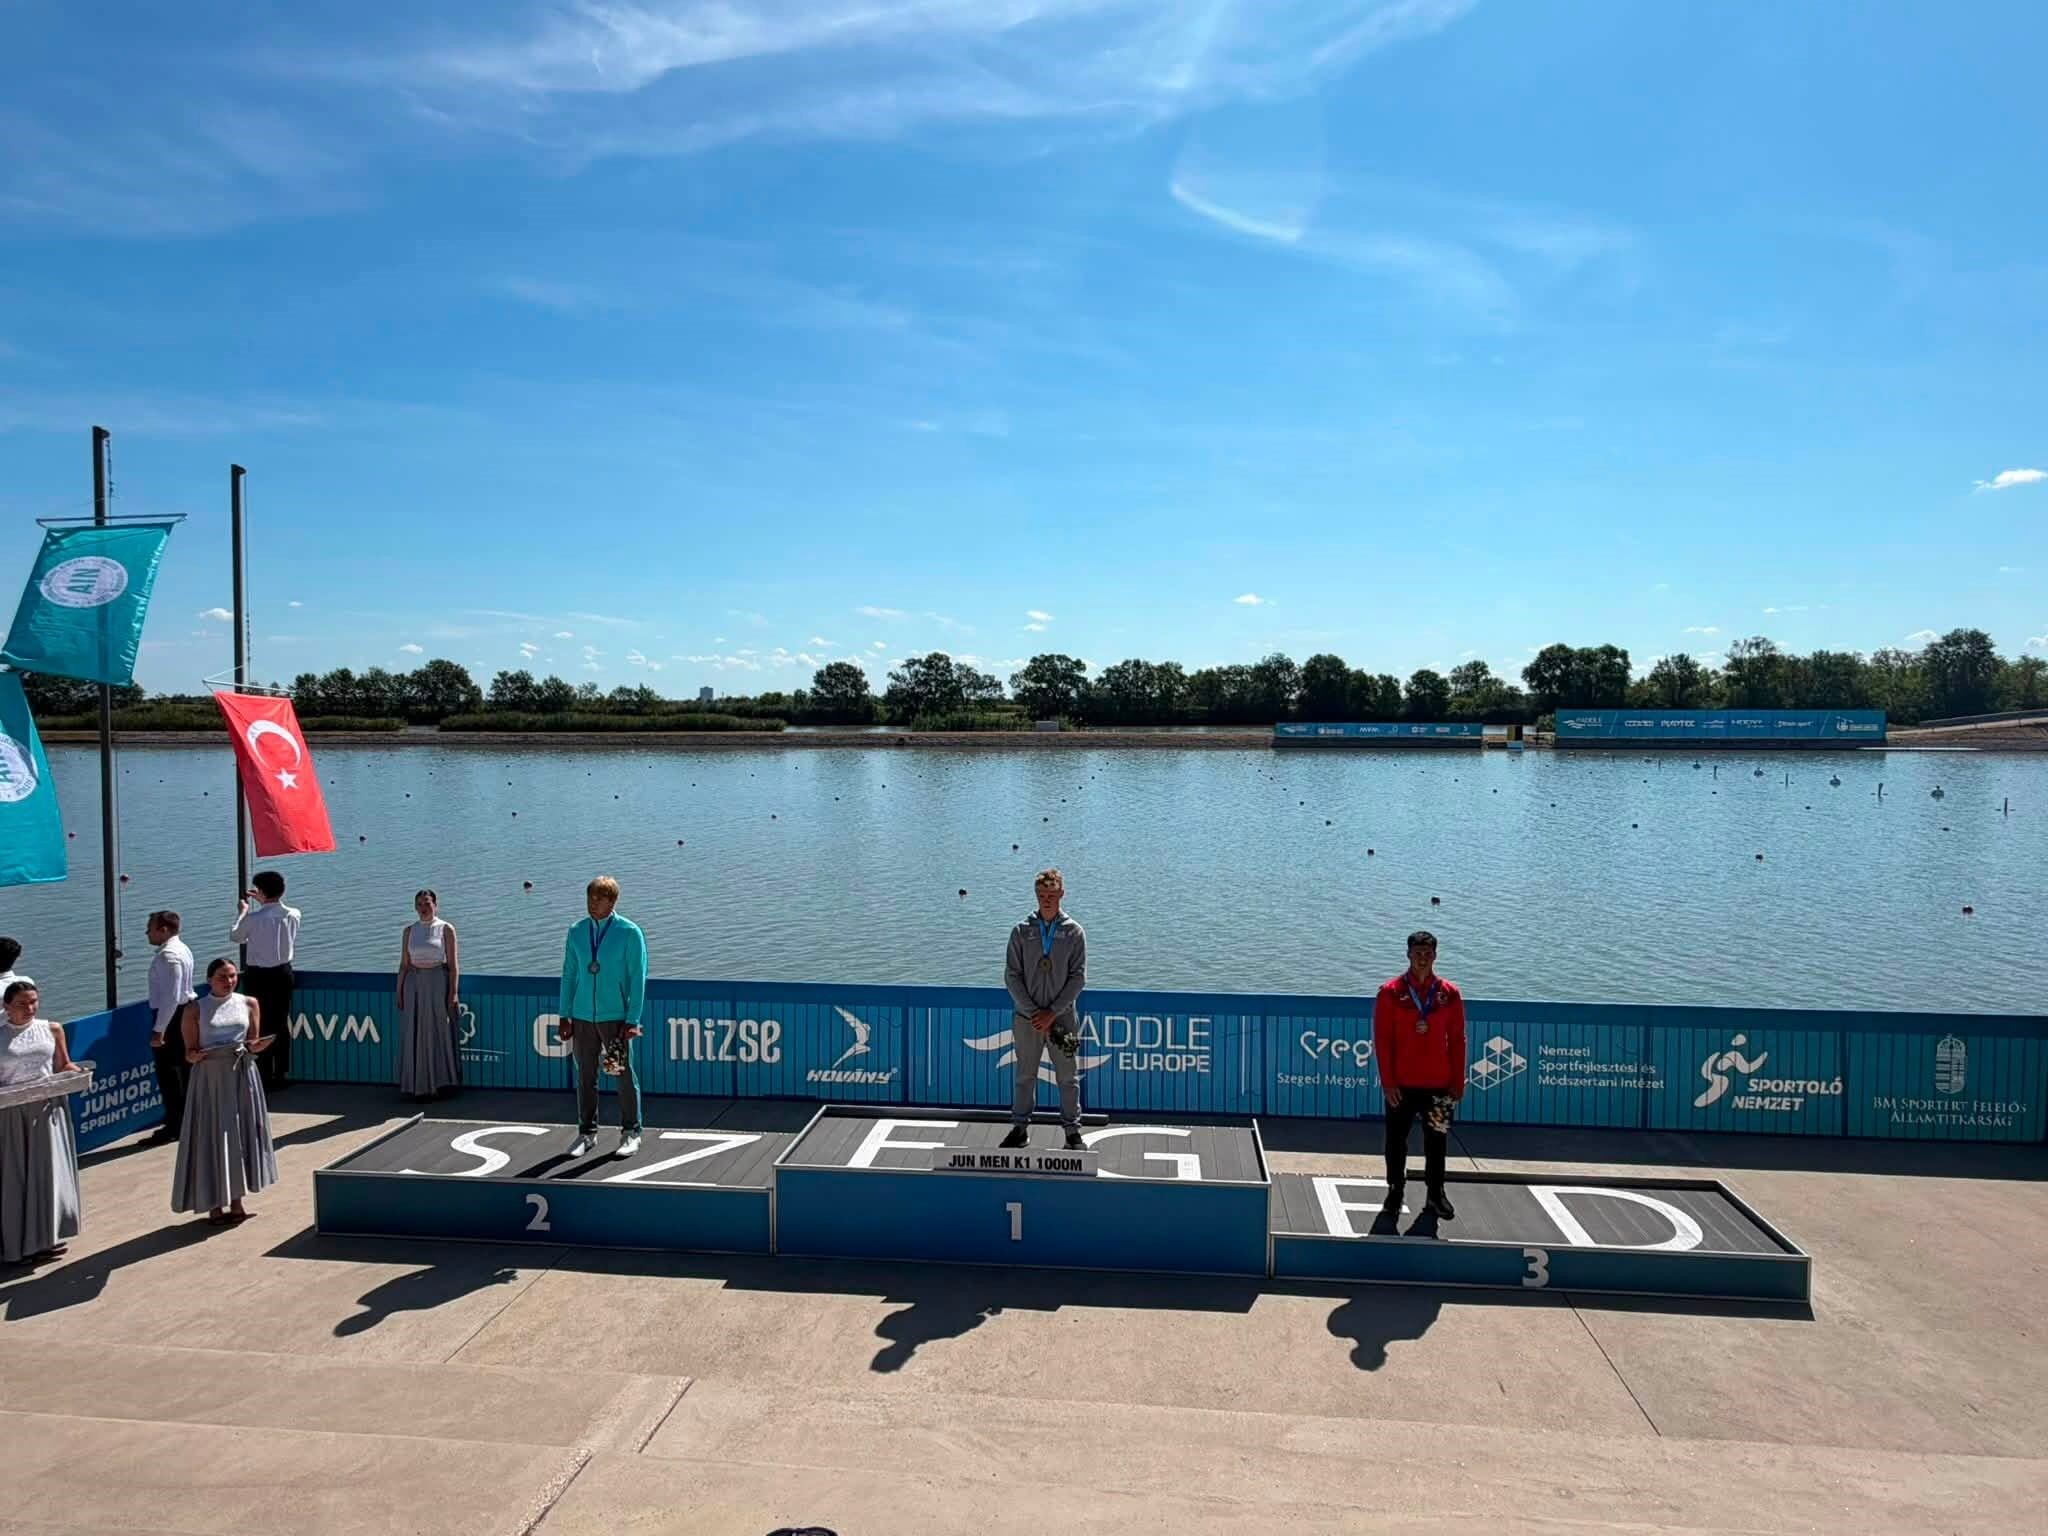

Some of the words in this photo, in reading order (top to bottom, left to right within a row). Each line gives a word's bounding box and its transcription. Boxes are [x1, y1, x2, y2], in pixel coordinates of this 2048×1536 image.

[66, 568, 101, 595] AIN
[287, 1013, 380, 1043] MVM
[1078, 1015, 1210, 1050] ADDLE
[1119, 1052, 1210, 1073] EUROPE
[1539, 1045, 1590, 1057] Nemzeti
[1277, 1072, 1320, 1087] Szeged
[1538, 1074, 1618, 1088] Módszertani
[1620, 1077, 1665, 1089] Intézet
[1748, 1076, 1843, 1095] SPORTOLÓ
[80, 1080, 151, 1118] JUNIOR
[1731, 1095, 1805, 1111] NEMZET
[1873, 1096, 1897, 1110] BM
[80, 1106, 128, 1134] SPRINT
[949, 1155, 975, 1168] JUN
[980, 1155, 1010, 1168] MEN
[1015, 1156, 1030, 1169] K1
[1036, 1157, 1082, 1171] 1000M
[526, 1194, 550, 1231] 2
[1006, 1202, 1022, 1241] 1
[1522, 1248, 1550, 1288] 3
